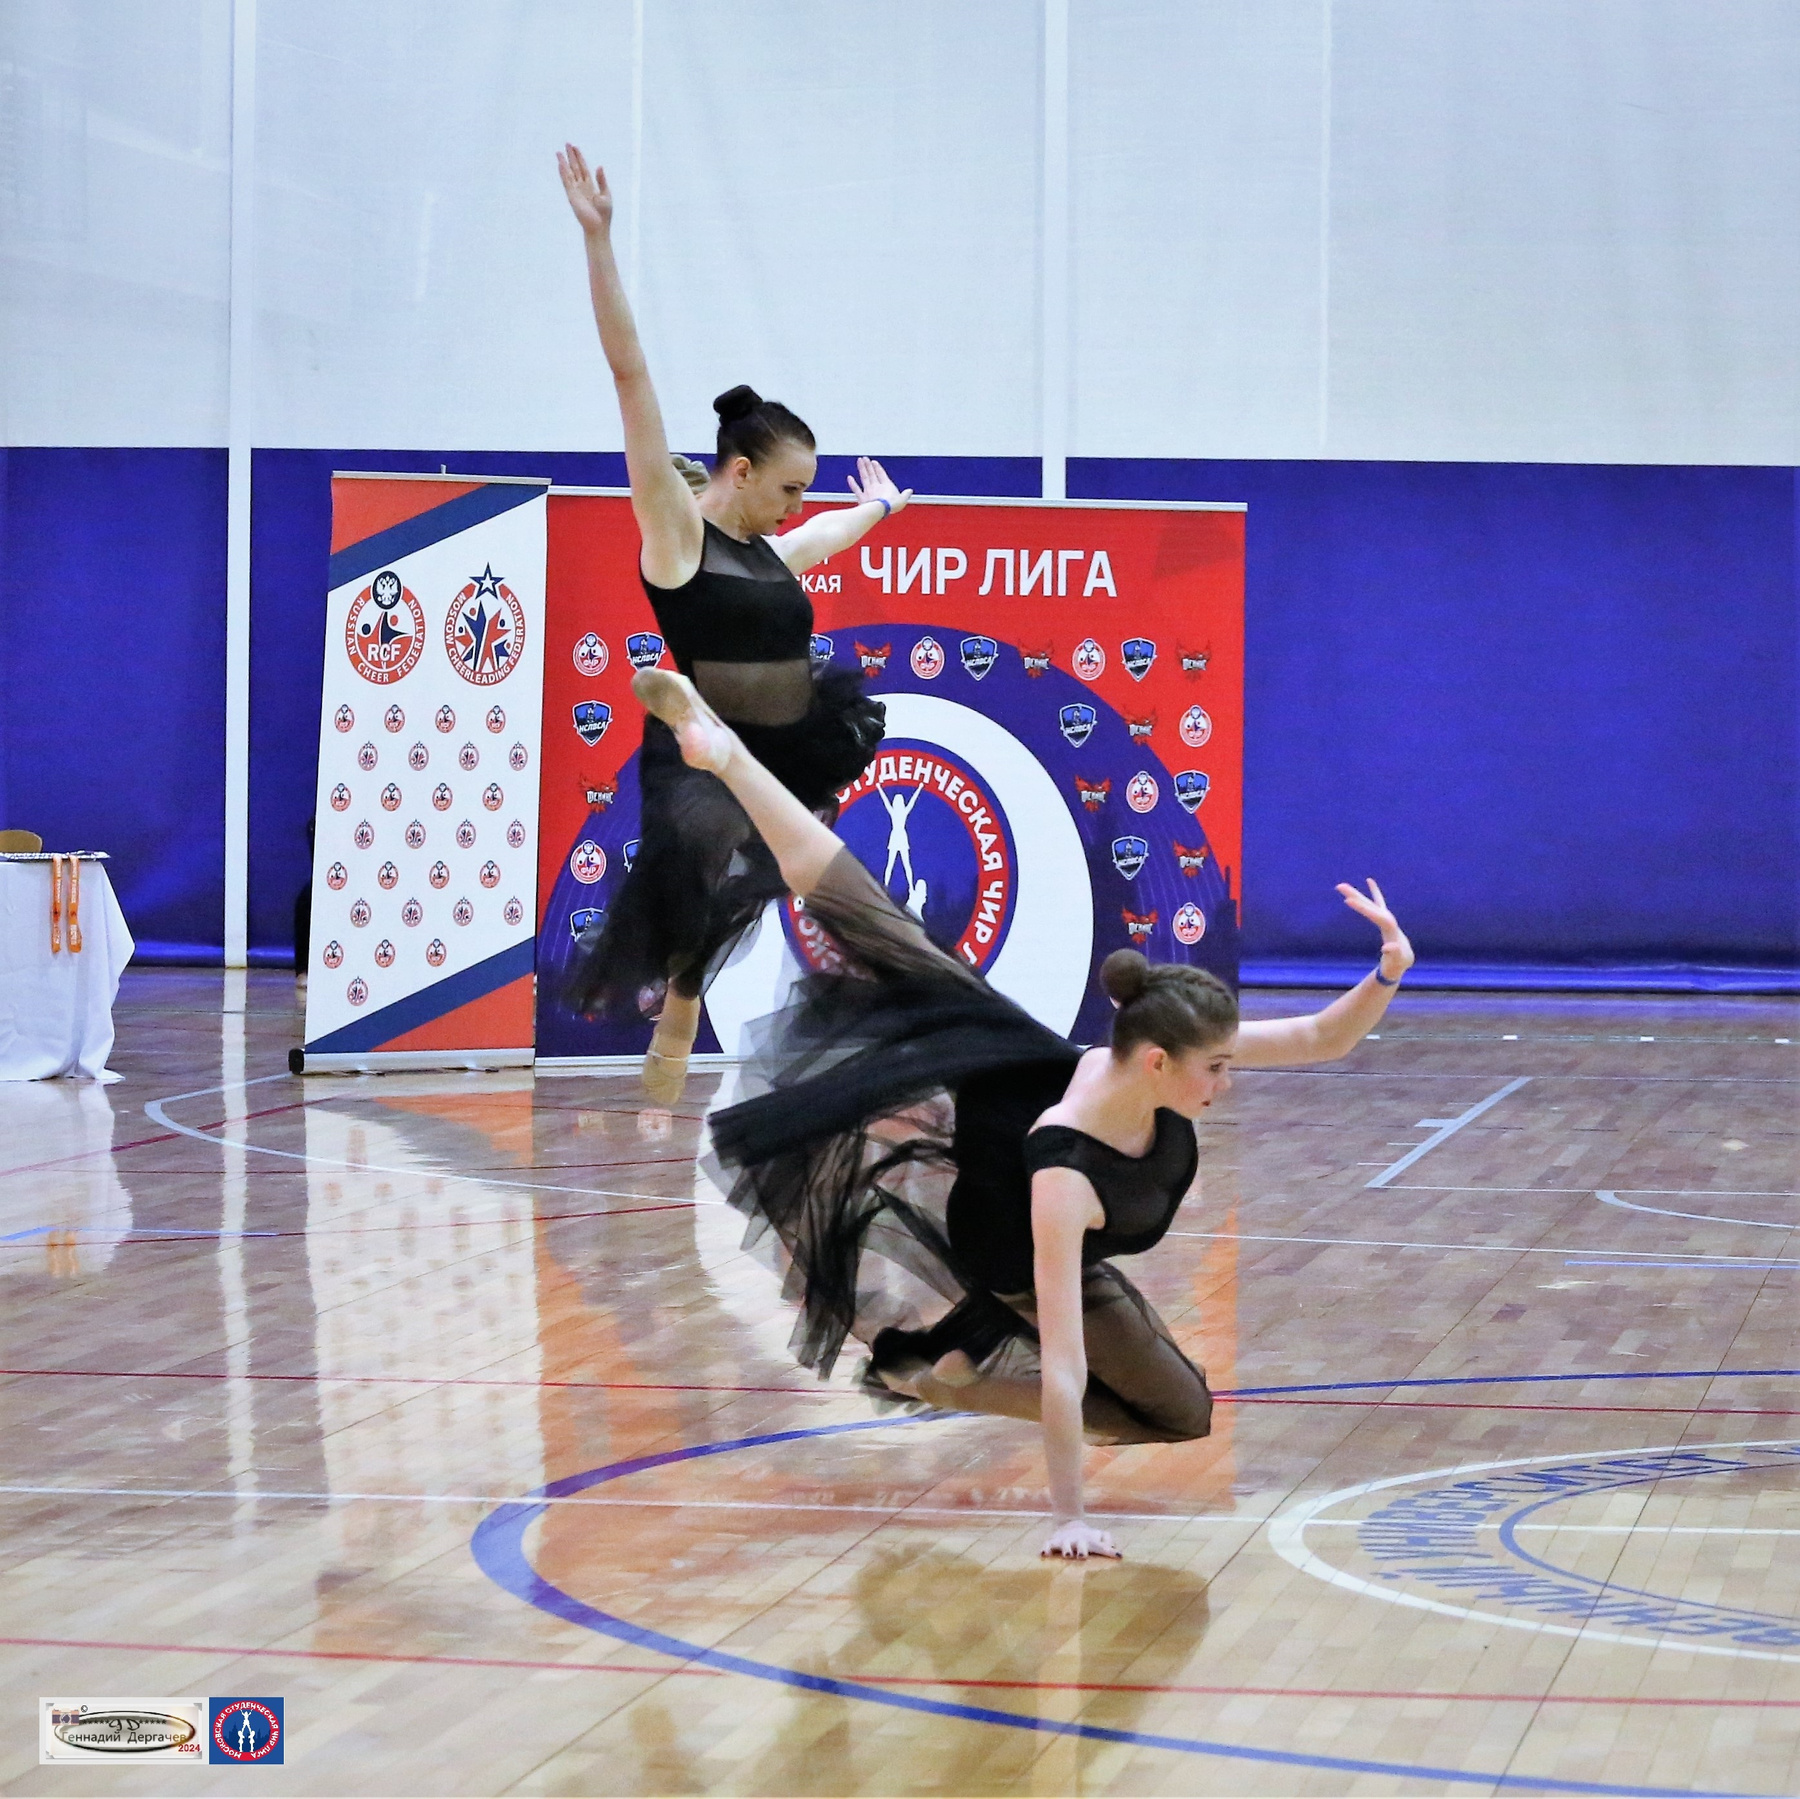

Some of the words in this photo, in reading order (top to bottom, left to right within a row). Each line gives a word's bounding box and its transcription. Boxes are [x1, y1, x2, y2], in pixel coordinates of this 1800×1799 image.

[795, 574, 842, 593] КАЯ
[860, 546, 967, 594] ЧИР
[978, 549, 1117, 597] ЛИГА
[347, 597, 365, 656] RUSSIAN
[358, 662, 389, 683] CHEER
[396, 599, 424, 677] FEDERATION
[445, 592, 467, 644] MOSCOW
[505, 593, 524, 665] FEDERATION
[367, 643, 402, 662] RCF
[448, 648, 510, 684] CHEERLEADING
[974, 881, 1003, 944] ЧИР
[1357, 1453, 1749, 1560] УНИВЕРСИТЕТ
